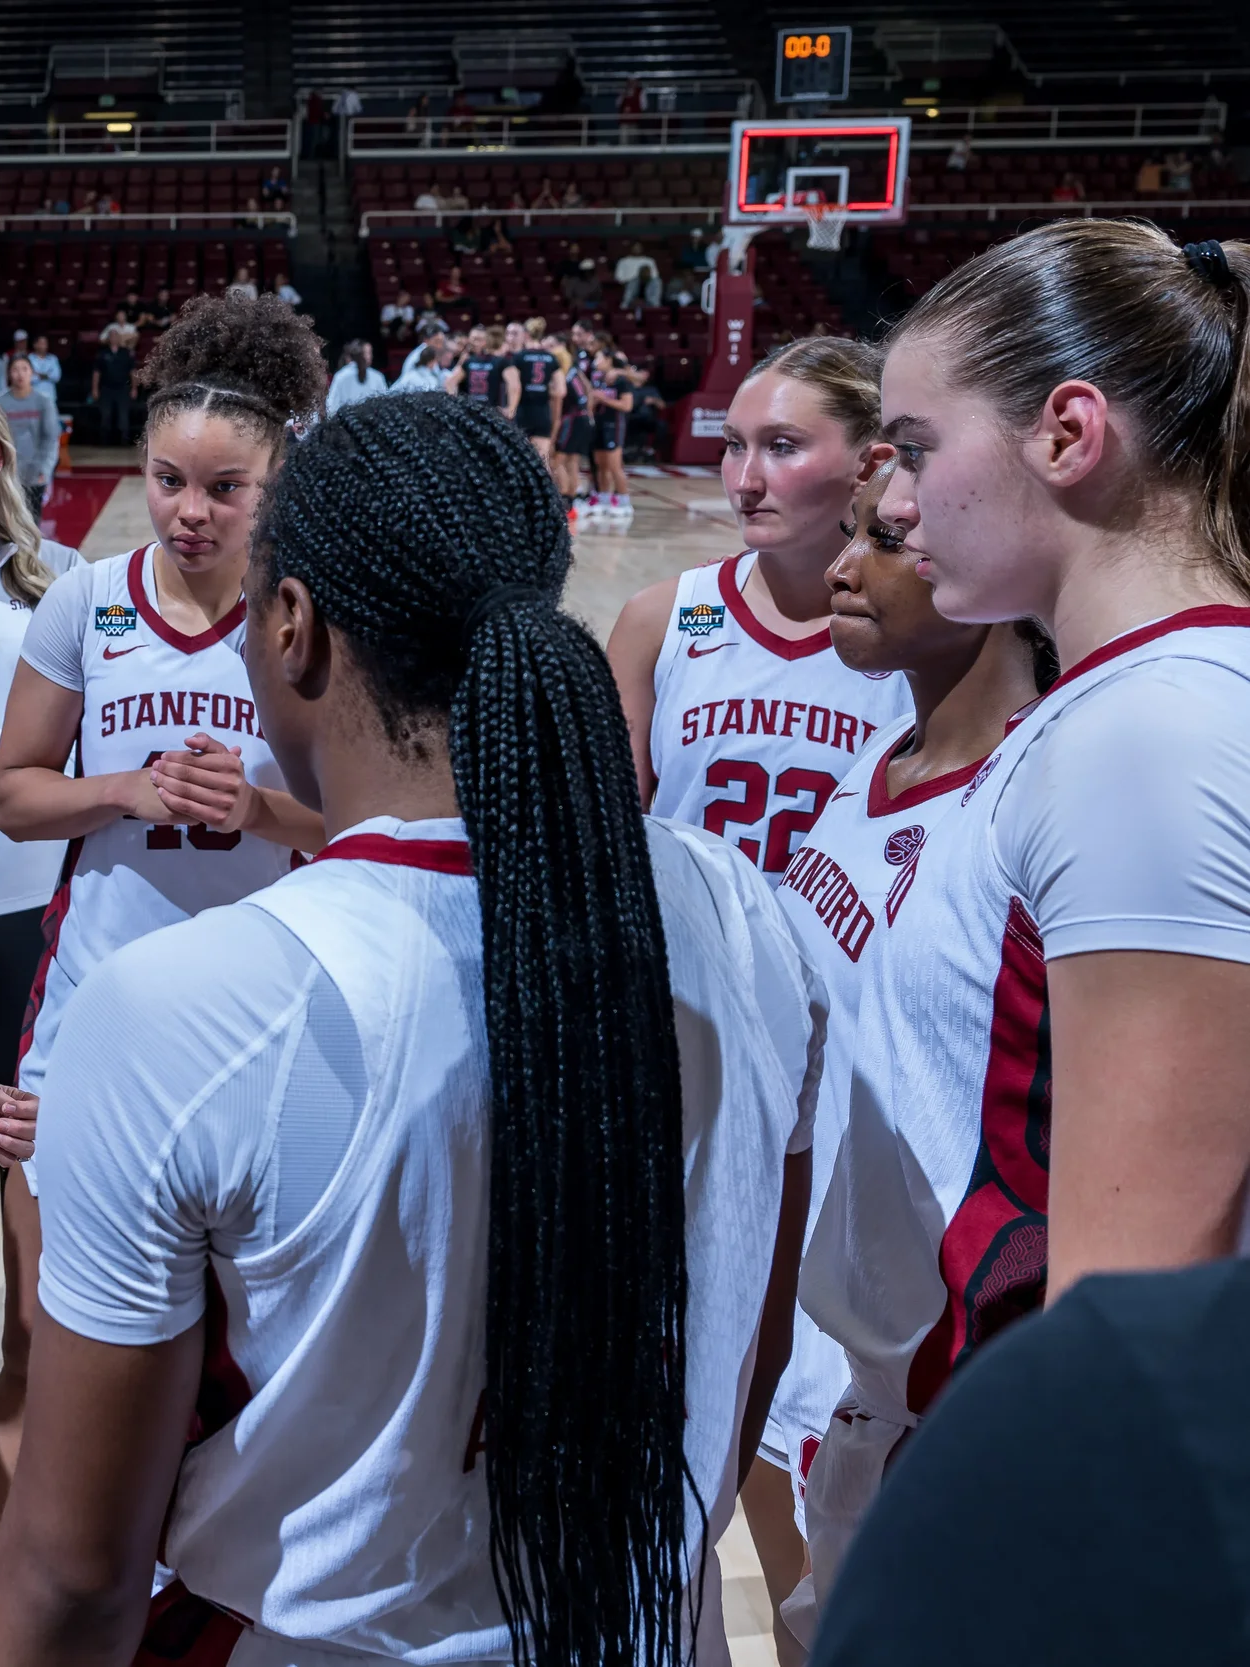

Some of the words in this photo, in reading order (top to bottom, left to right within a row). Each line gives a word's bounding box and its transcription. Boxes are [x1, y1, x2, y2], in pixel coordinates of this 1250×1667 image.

[96, 615, 136, 627] WBIT
[680, 614, 723, 625] WBIT
[101, 691, 264, 739] STANFOR
[703, 757, 841, 873] 22
[892, 835, 918, 851] ACC
